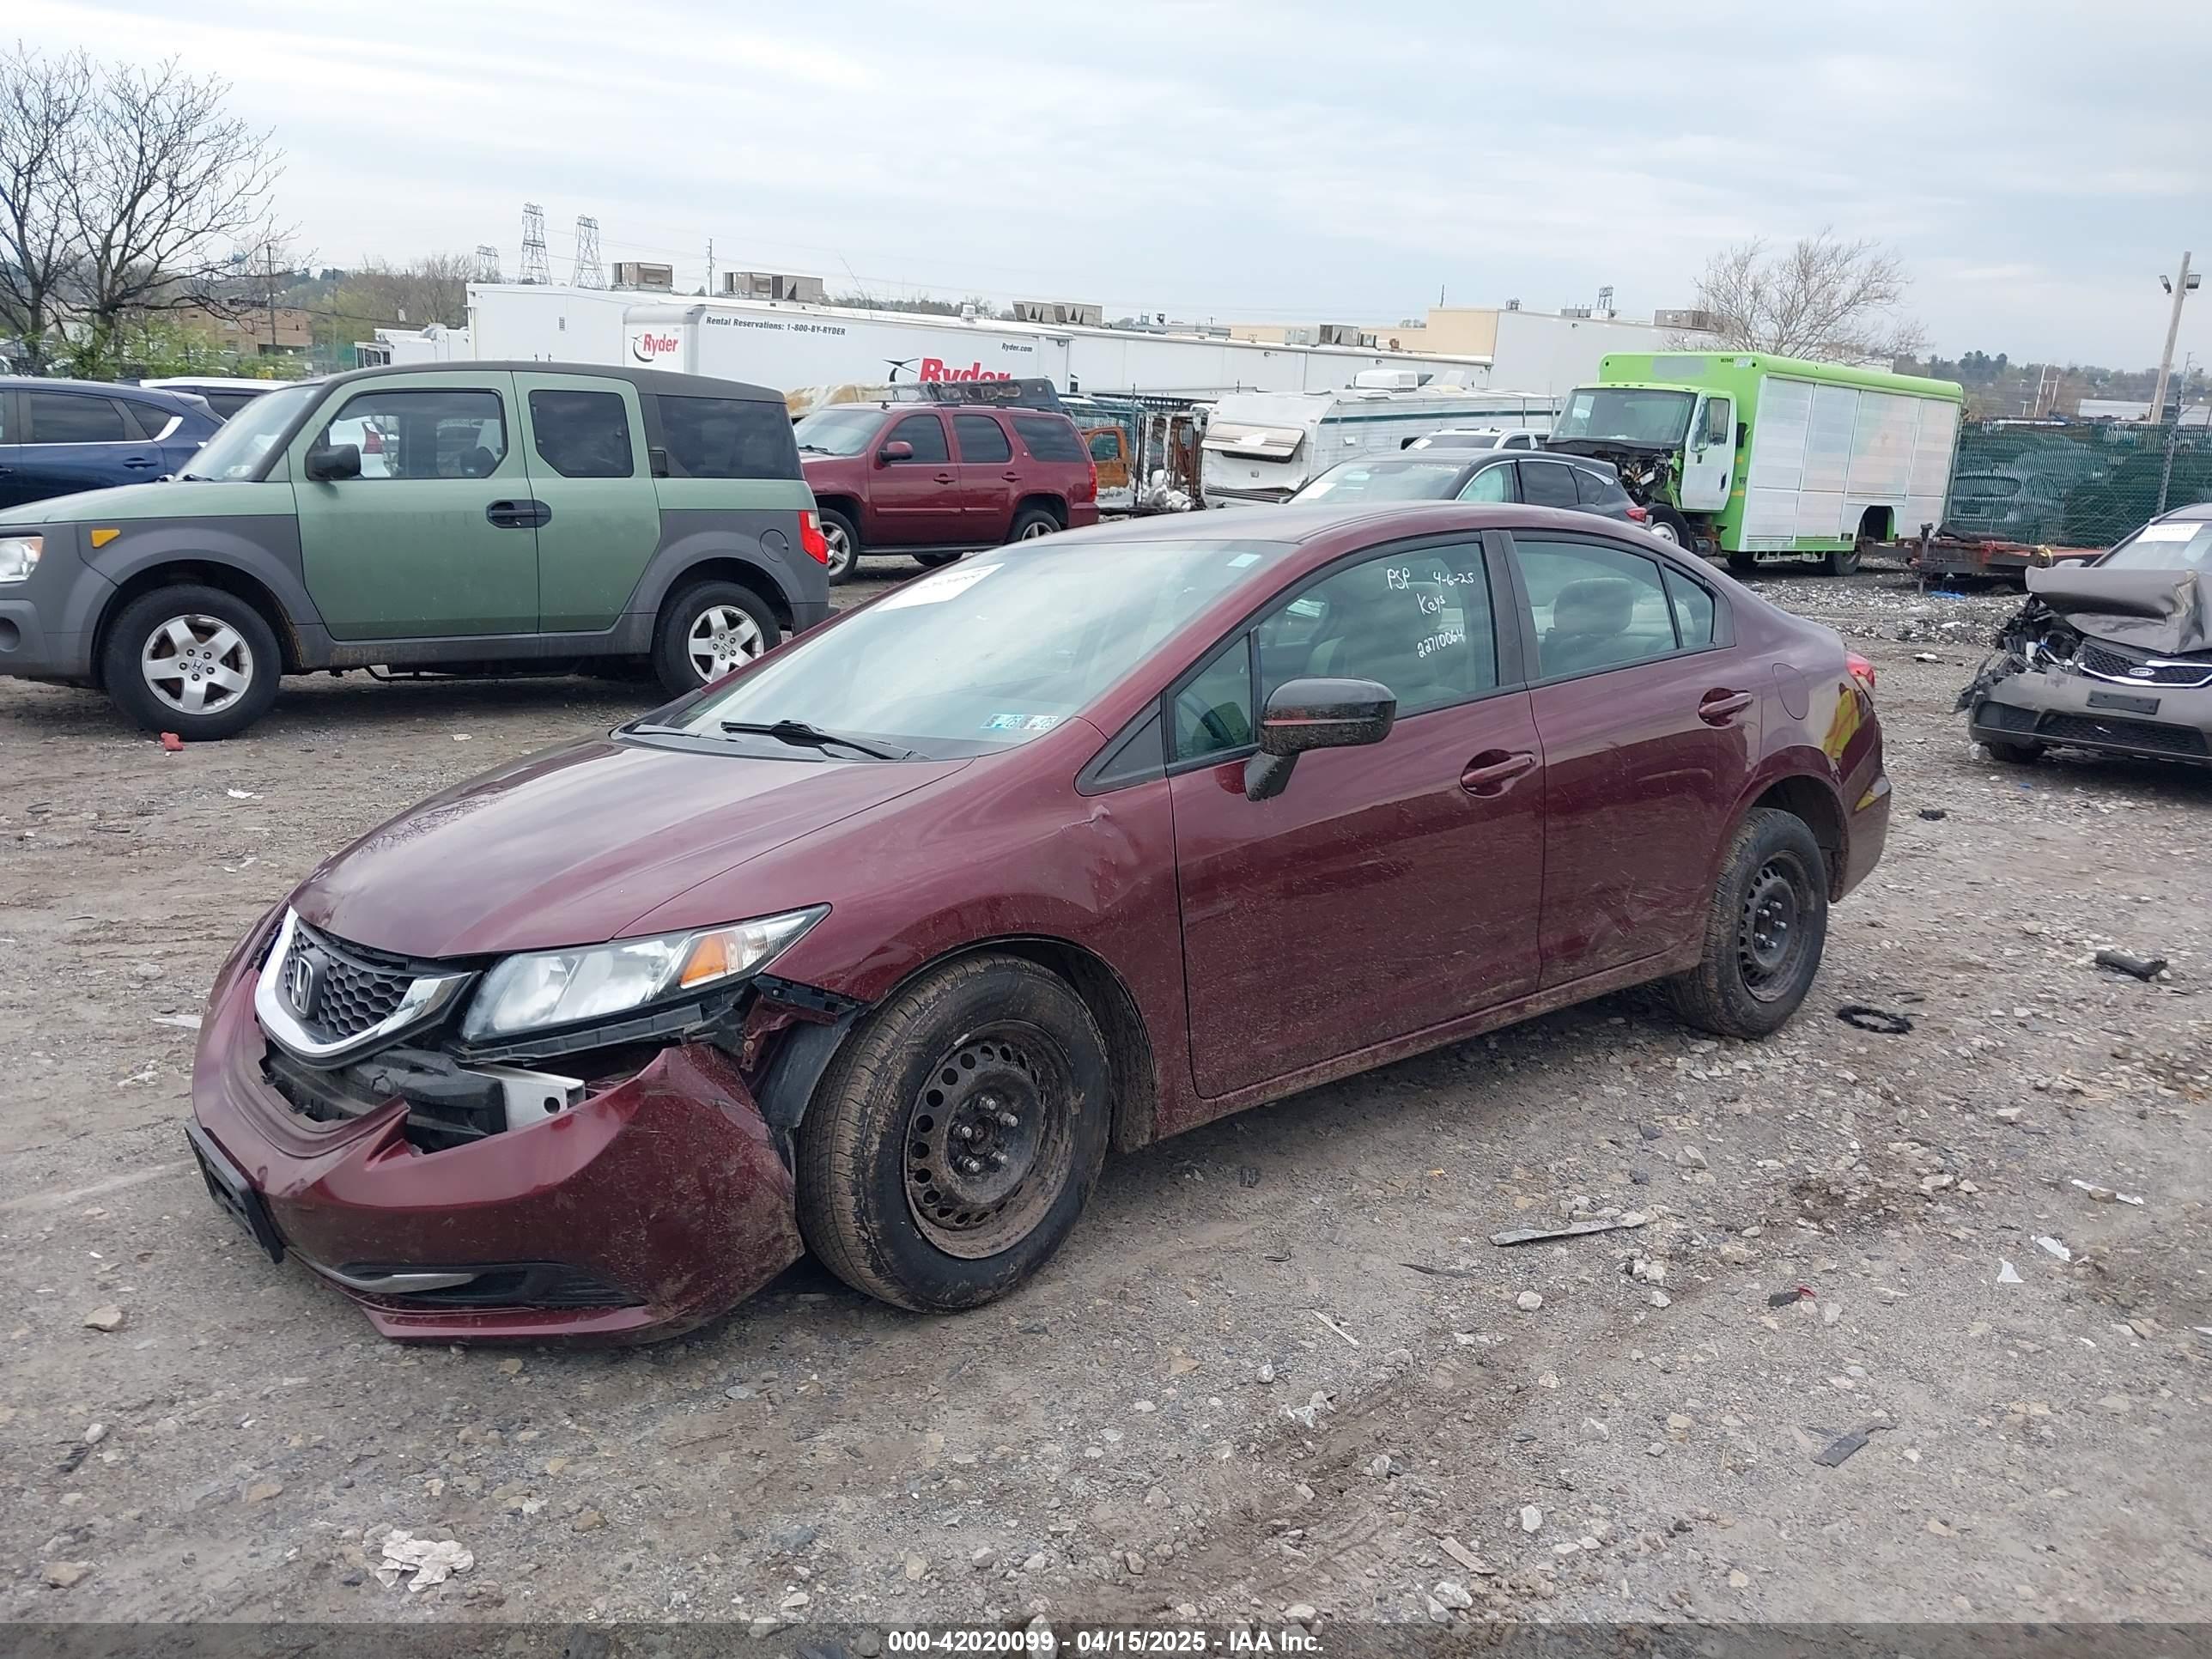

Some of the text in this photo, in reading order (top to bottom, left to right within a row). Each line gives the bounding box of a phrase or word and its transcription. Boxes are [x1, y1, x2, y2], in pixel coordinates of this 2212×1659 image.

[706, 316, 732, 326] Rental
[733, 318, 785, 331] Reservations:
[643, 333, 678, 356] Ryder
[1001, 343, 1033, 352] Ryder.com
[1387, 568, 1474, 590] PSP 4-6-25
[1417, 592, 1446, 616] Keys
